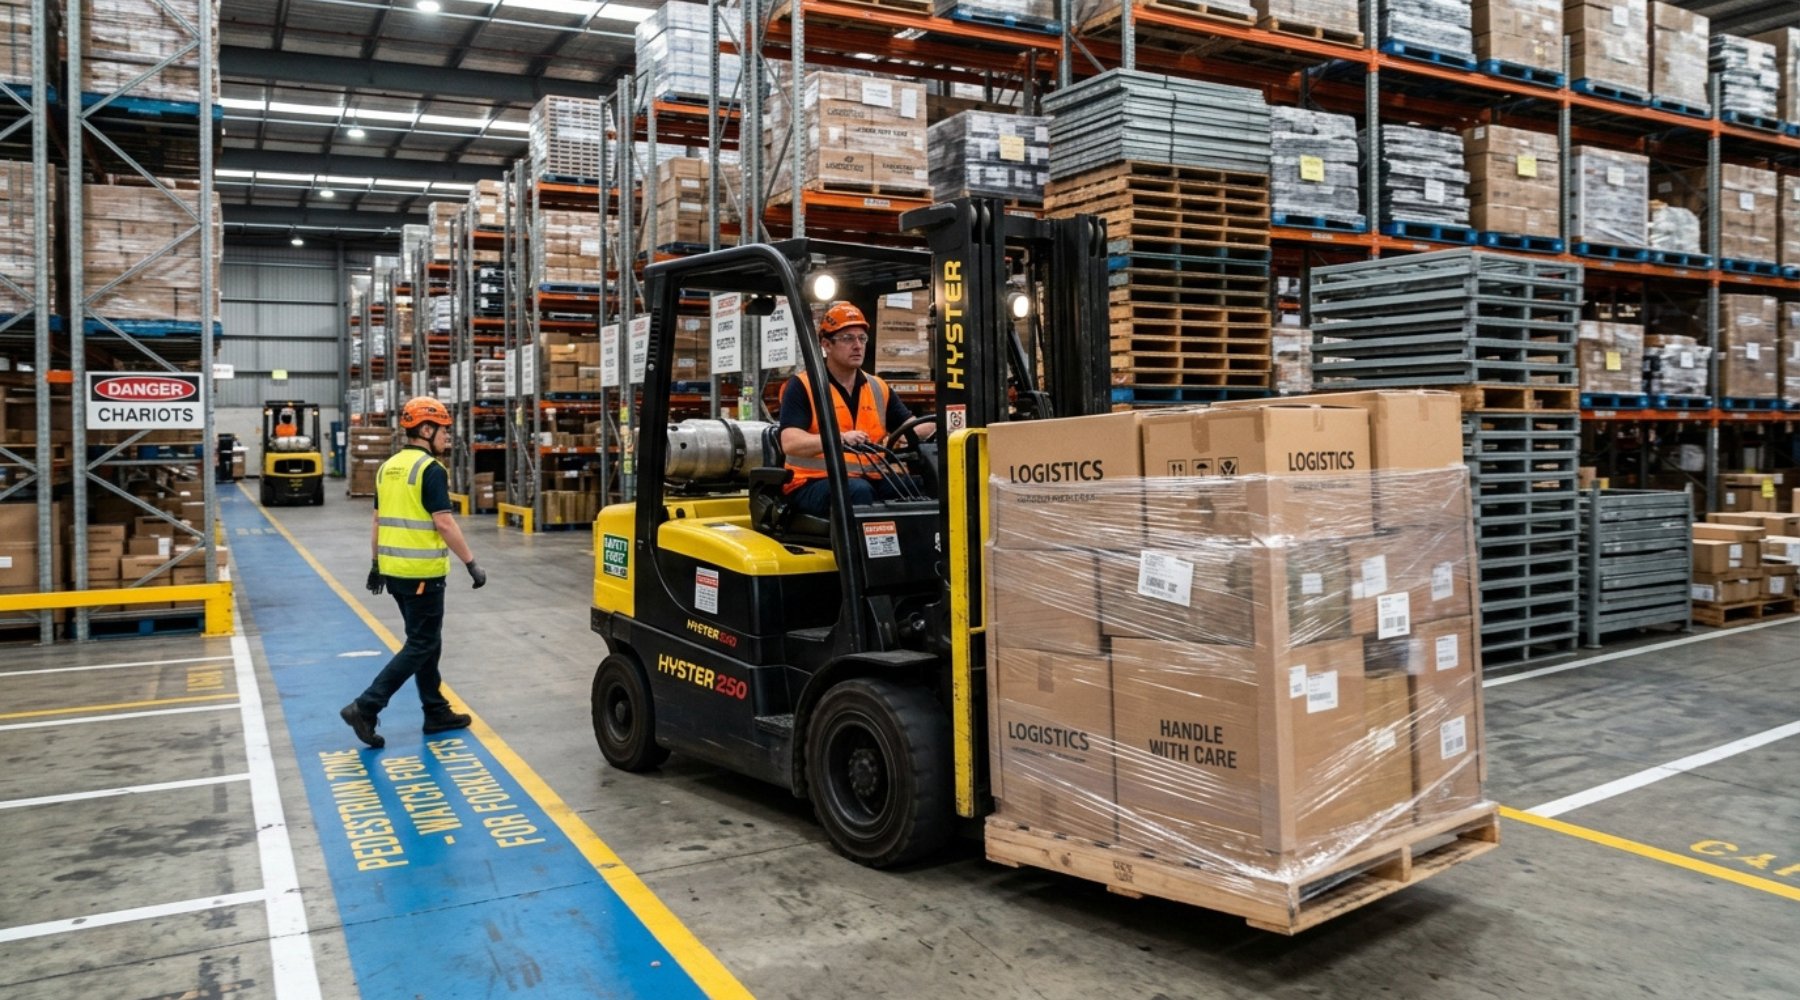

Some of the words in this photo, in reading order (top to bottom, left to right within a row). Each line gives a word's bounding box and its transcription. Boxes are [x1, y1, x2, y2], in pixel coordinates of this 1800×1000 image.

[944, 260, 965, 390] HYSTER
[107, 382, 184, 396] DANGER
[98, 407, 194, 422] CHARIOTS
[1010, 459, 1104, 484] LOGISTICS
[1287, 451, 1355, 472] LOGISTICS
[658, 653, 715, 690] HYSTER
[715, 674, 748, 700] 250
[1008, 721, 1090, 752] LOGISTICS
[1160, 719, 1224, 745] HANDLE
[318, 749, 368, 781] ZONE
[381, 755, 431, 782] FOR
[1149, 739, 1189, 762] WITH
[1194, 745, 1237, 769] CARE
[395, 781, 463, 835] WATCH
[330, 779, 409, 871] PEDESTRIAN
[482, 813, 546, 848] FOR
